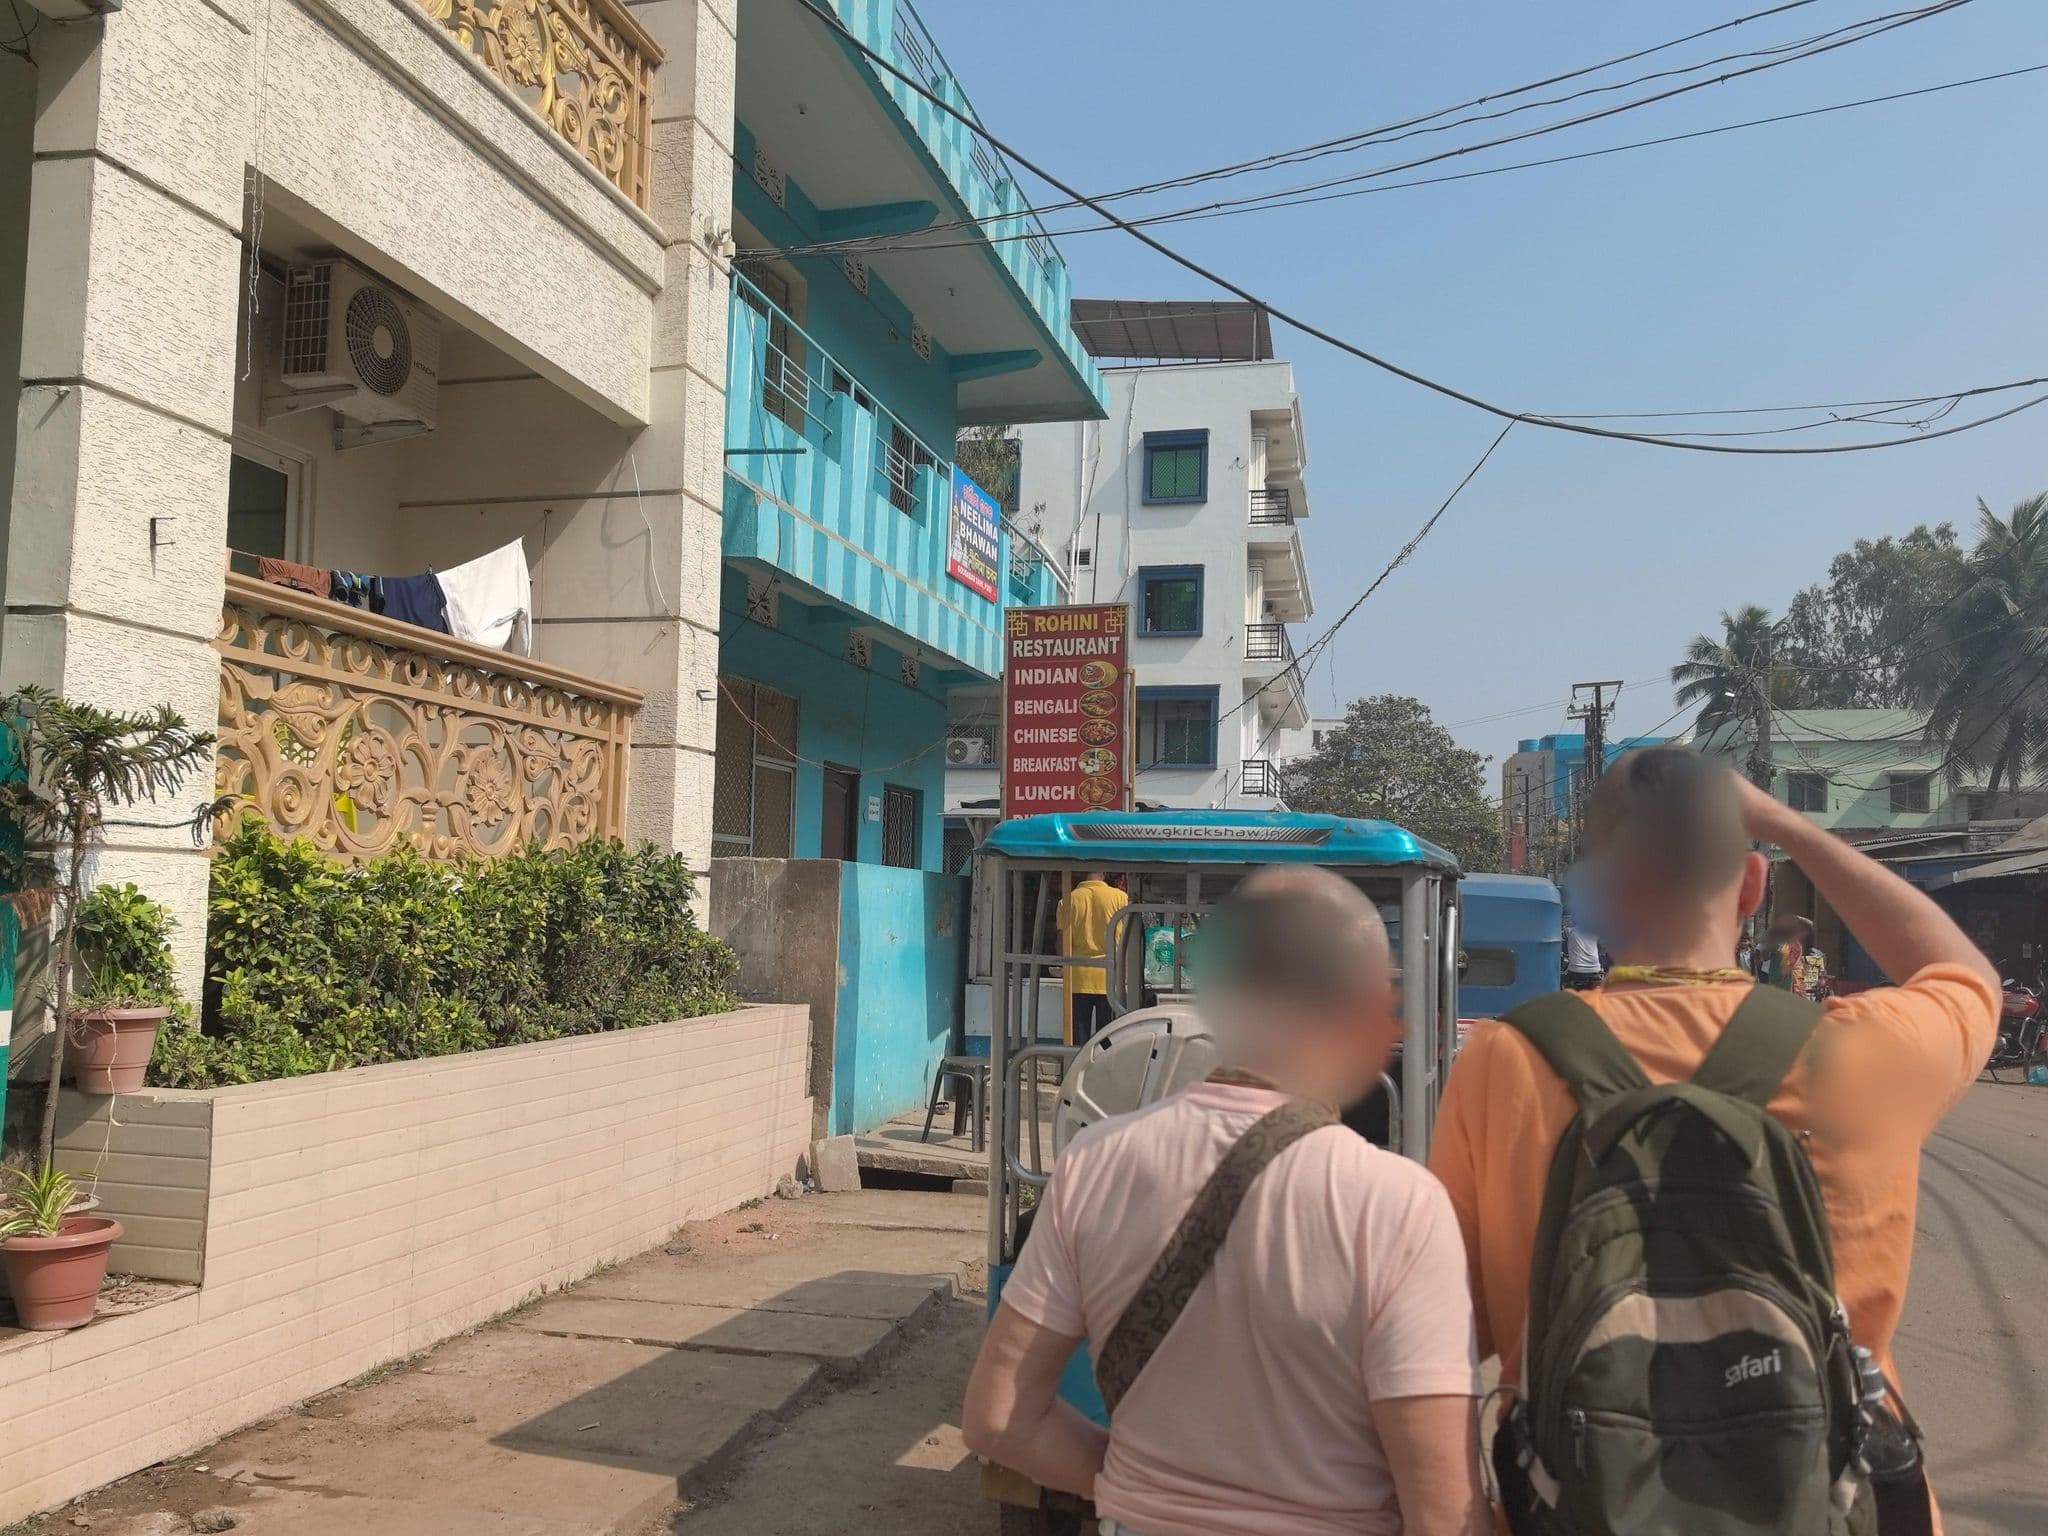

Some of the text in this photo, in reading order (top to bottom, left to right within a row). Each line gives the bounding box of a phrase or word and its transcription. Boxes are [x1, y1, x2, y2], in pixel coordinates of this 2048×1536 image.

[960, 500, 998, 542] NEELIMA
[960, 524, 997, 561] BHAWAN
[1034, 614, 1098, 632] ROHINI
[1013, 637, 1120, 657] RESTAURANT
[1015, 667, 1077, 685] INDIAN
[1014, 699, 1077, 715] BENGALI
[1014, 728, 1077, 744] CHINESE
[1013, 757, 1077, 773] BREAKFAST
[1015, 785, 1076, 800] LUNCH
[1116, 826, 1281, 838] www.gkrickshaw.in
[1724, 1348, 1782, 1389] safari
